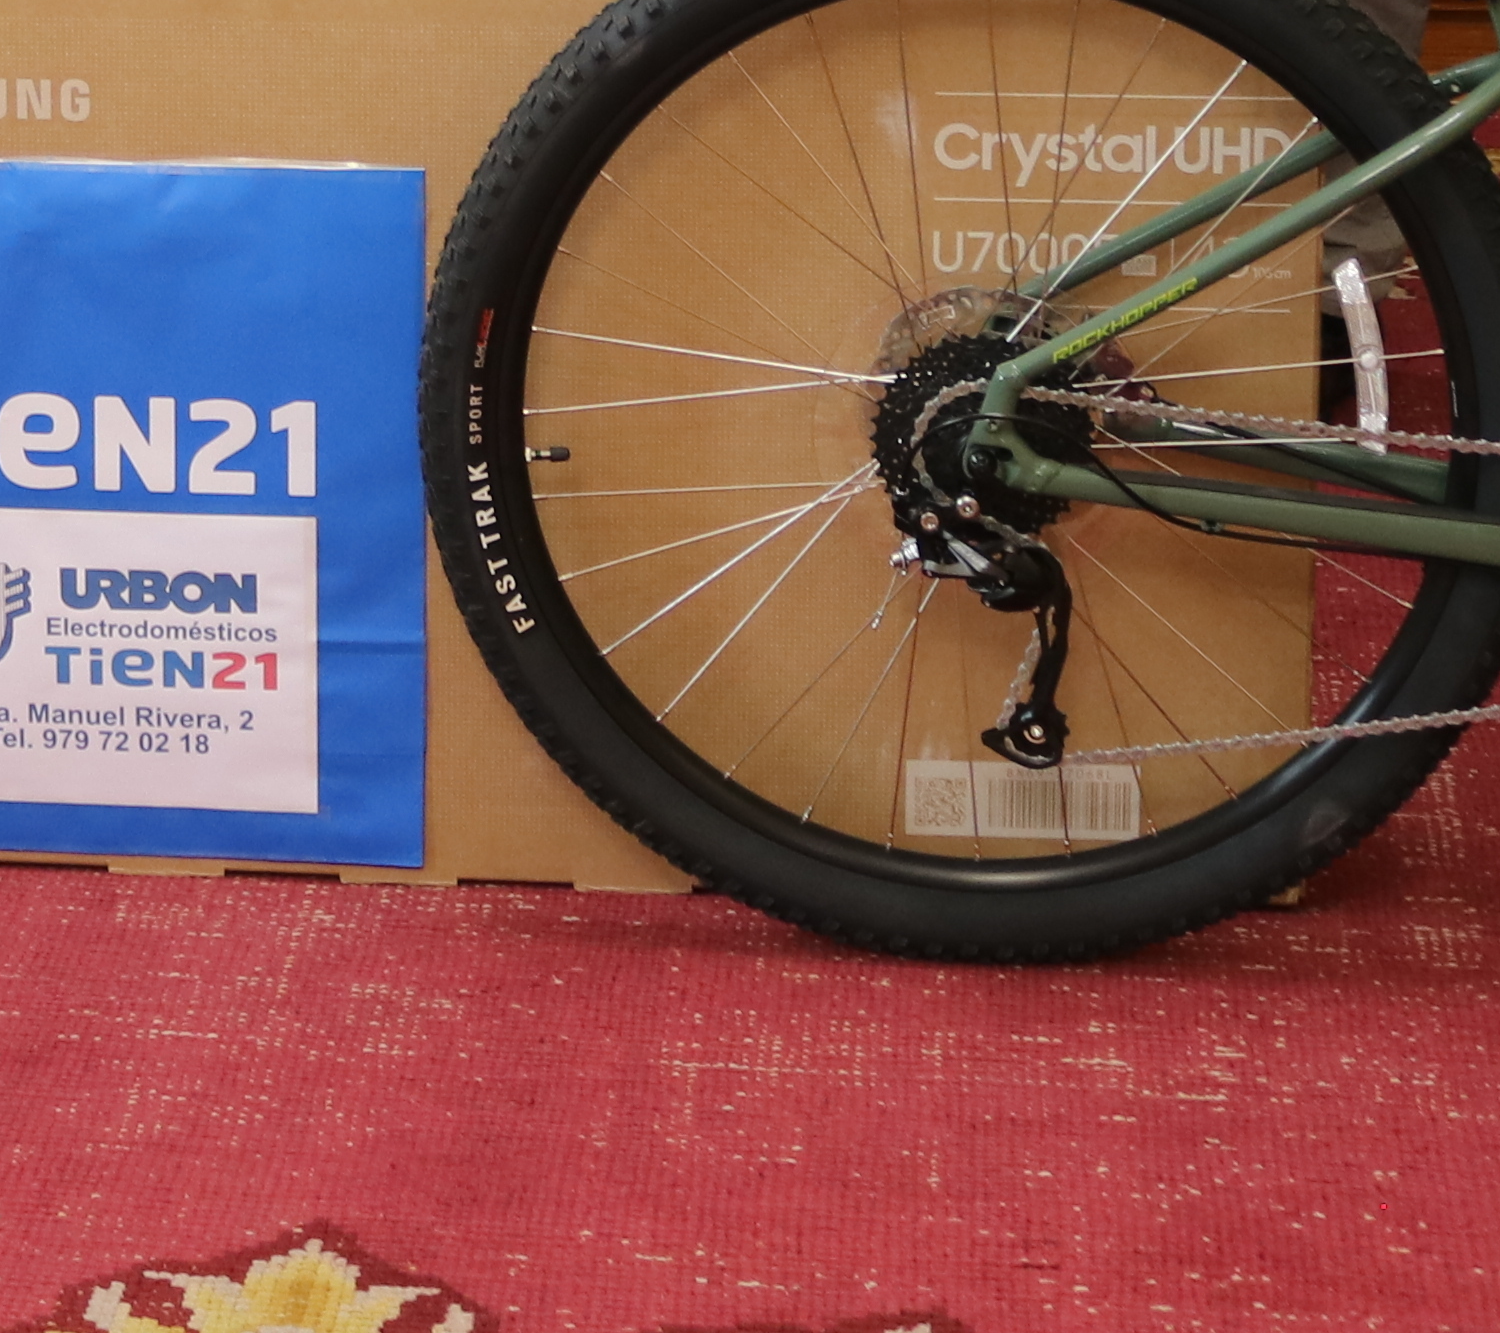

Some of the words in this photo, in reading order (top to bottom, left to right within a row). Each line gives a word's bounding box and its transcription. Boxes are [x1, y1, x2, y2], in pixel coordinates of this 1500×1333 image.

[934, 123, 1156, 187] Crystal
[1173, 126, 1294, 175] UHD
[1052, 277, 1198, 365] ROCKHOPPER
[469, 383, 484, 445] SPORT
[467, 461, 501, 550] TRAK
[58, 567, 258, 615] URBON
[486, 557, 536, 634] FAST
[46, 617, 278, 643] Electrodomésticos
[28, 702, 126, 727] Manuel
[135, 707, 230, 733] Rivera,
[239, 709, 254, 731] 2
[43, 729, 90, 751] 979
[100, 731, 128, 753] 72
[139, 733, 170, 753] 02
[180, 733, 210, 755] 18
